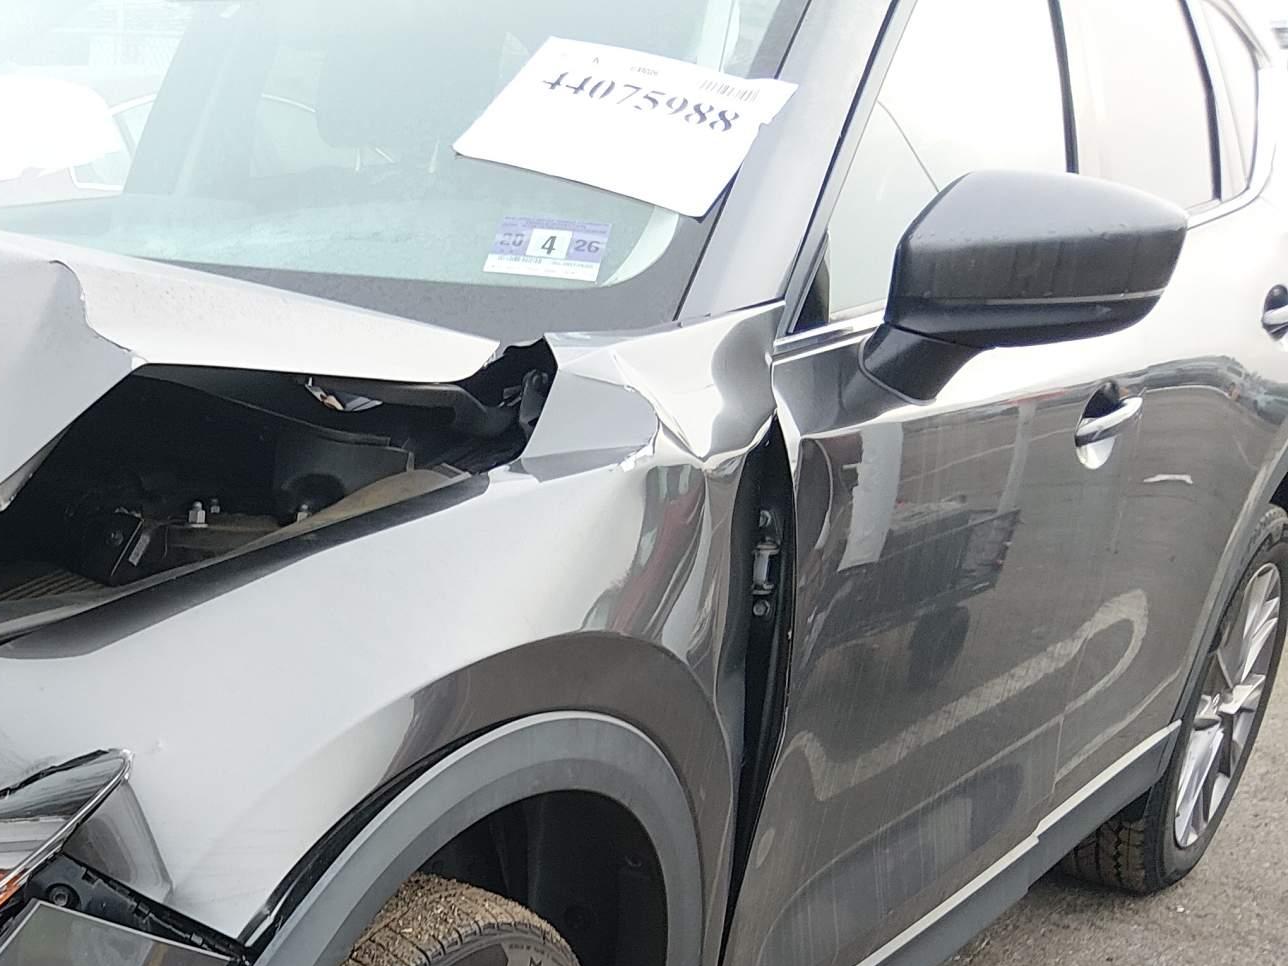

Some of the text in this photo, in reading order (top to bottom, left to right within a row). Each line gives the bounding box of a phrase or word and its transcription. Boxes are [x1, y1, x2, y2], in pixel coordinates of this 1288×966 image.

[543, 71, 740, 132] 44075988
[540, 235, 558, 255] 4
[574, 239, 601, 253] 26
